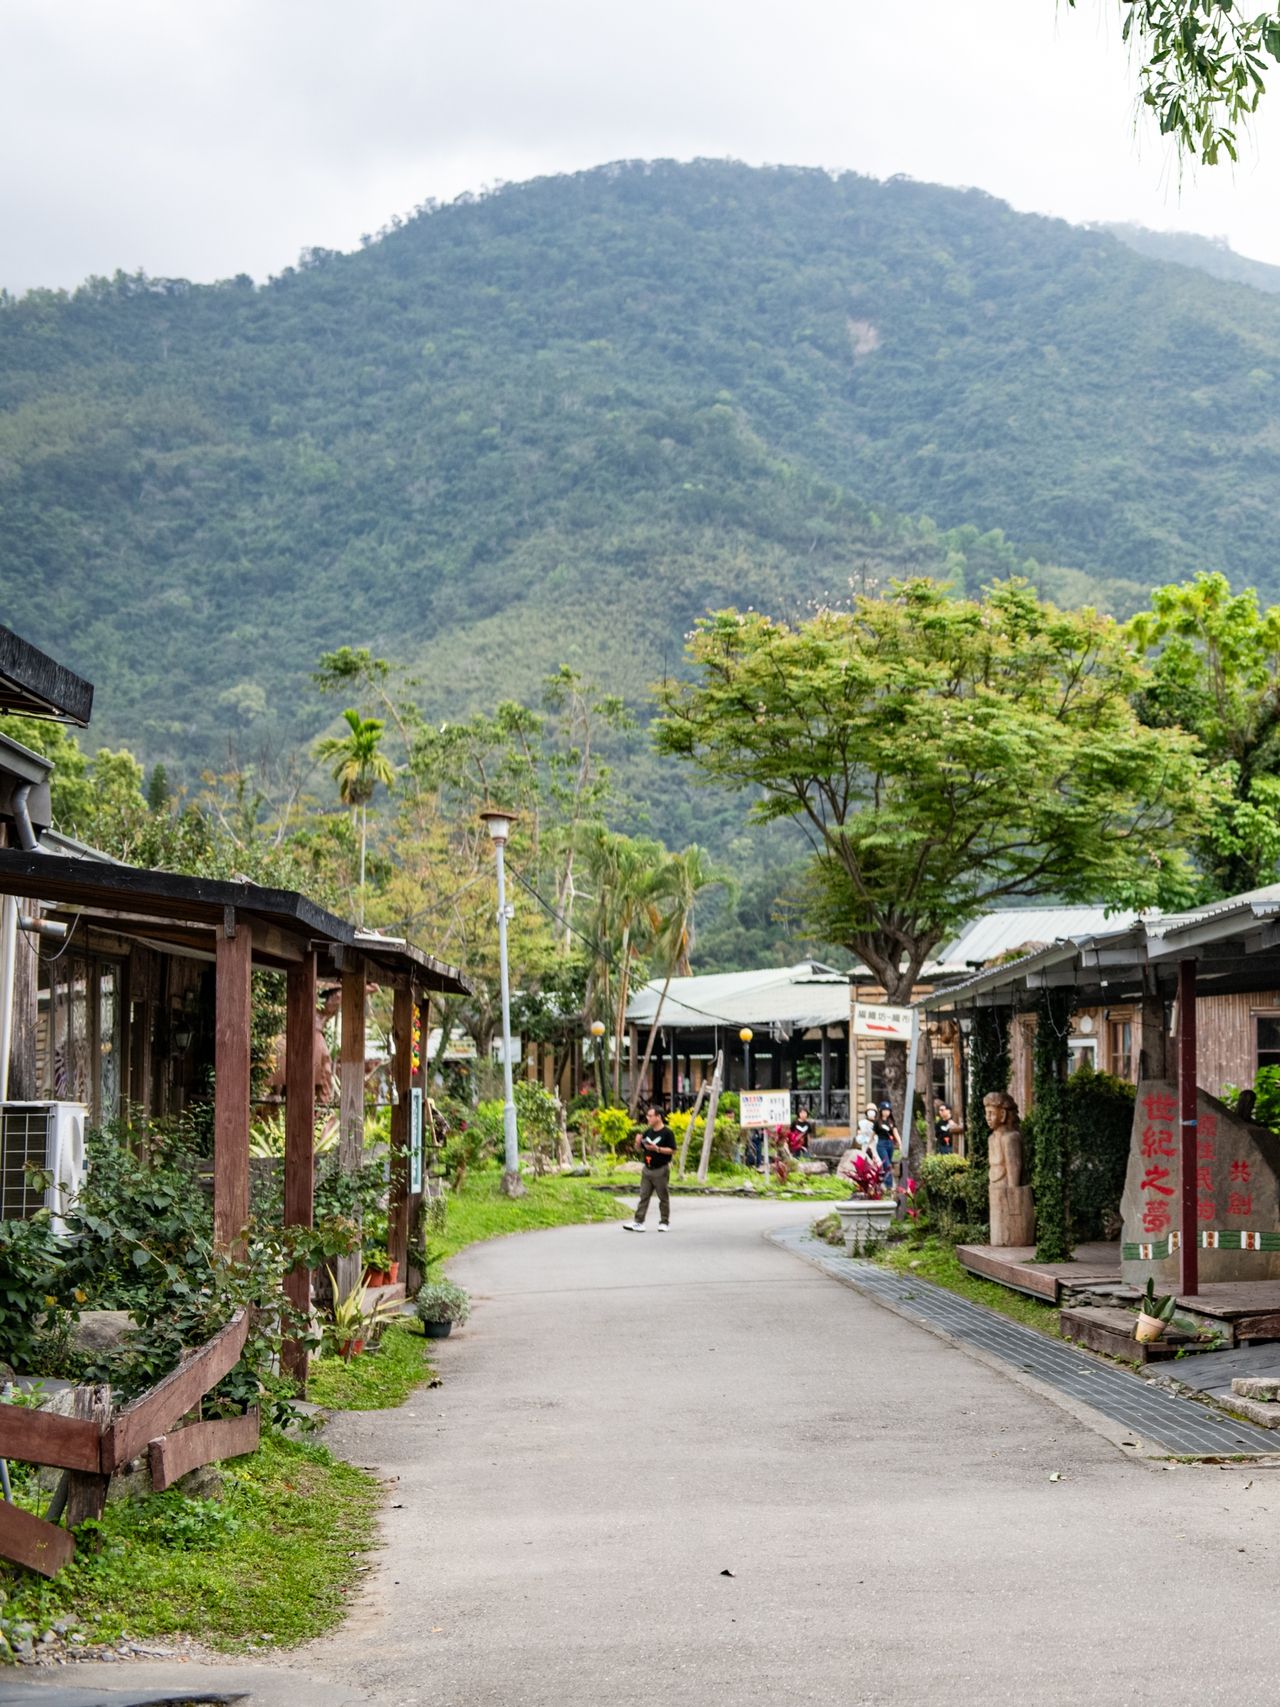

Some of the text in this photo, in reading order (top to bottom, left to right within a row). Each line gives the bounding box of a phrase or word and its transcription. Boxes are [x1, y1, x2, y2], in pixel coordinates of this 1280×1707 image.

[1140, 1093, 1178, 1233] 世紀之夢
[1226, 1159, 1253, 1216] 共創
